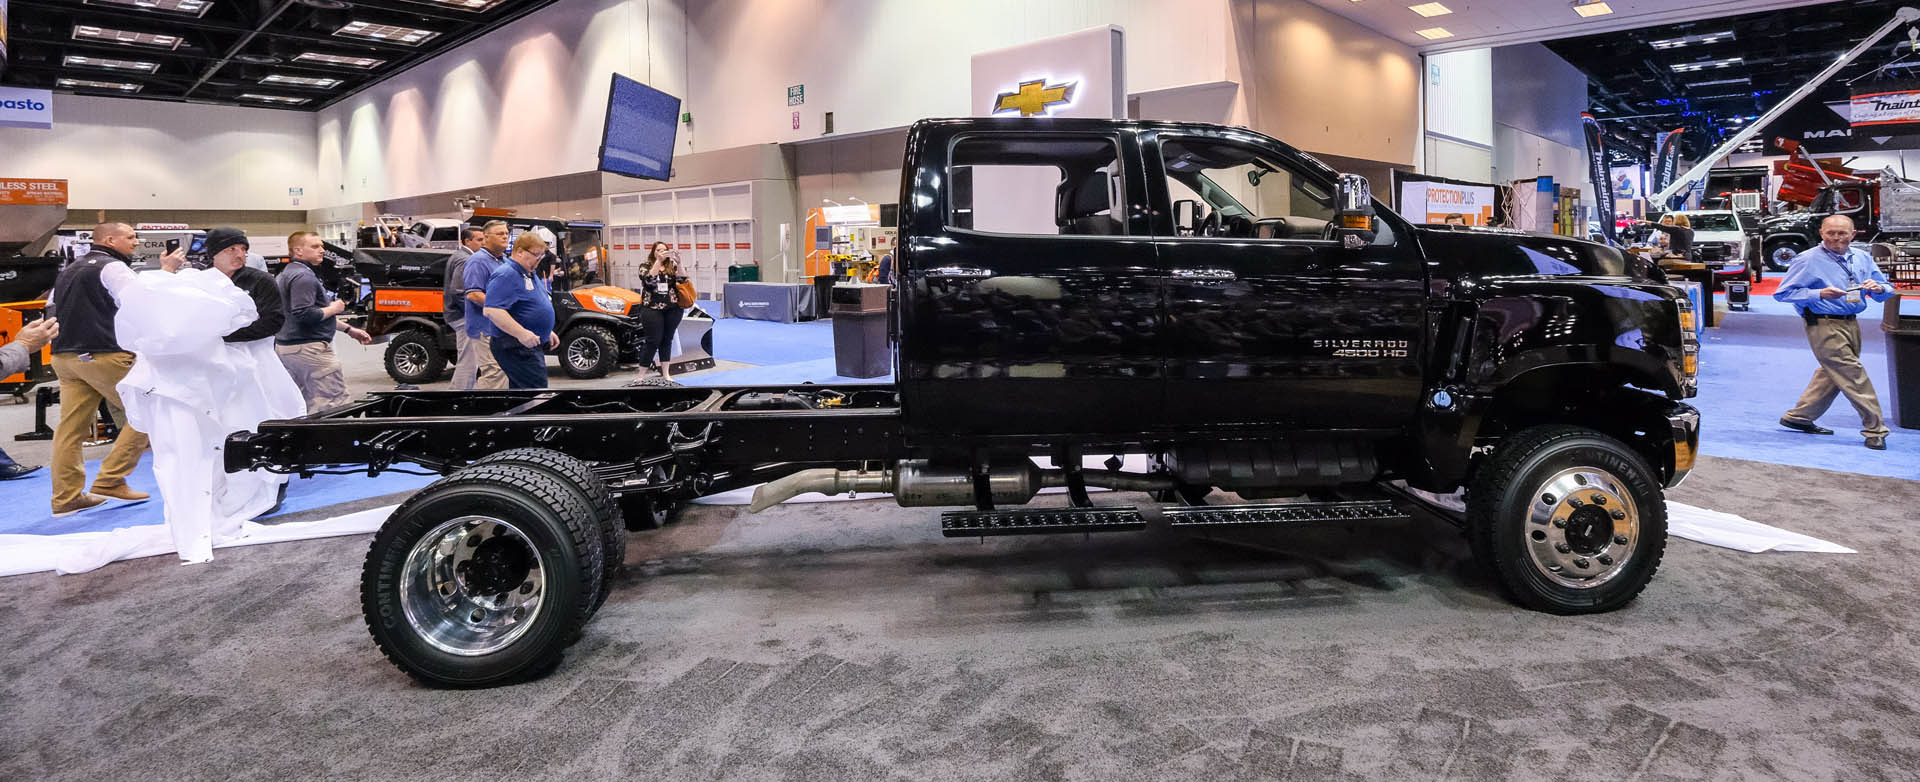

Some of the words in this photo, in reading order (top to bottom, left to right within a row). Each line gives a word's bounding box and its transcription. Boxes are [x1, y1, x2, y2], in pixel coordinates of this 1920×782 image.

[0, 98, 45, 111] asto
[789, 95, 803, 105] HOSE
[1594, 145, 1611, 216] Maintainer
[0, 182, 27, 190] LESS
[29, 182, 58, 190] STEEL
[1313, 339, 1408, 348] SILVERADO
[1332, 349, 1380, 358] 4500
[1383, 349, 1408, 358] HD
